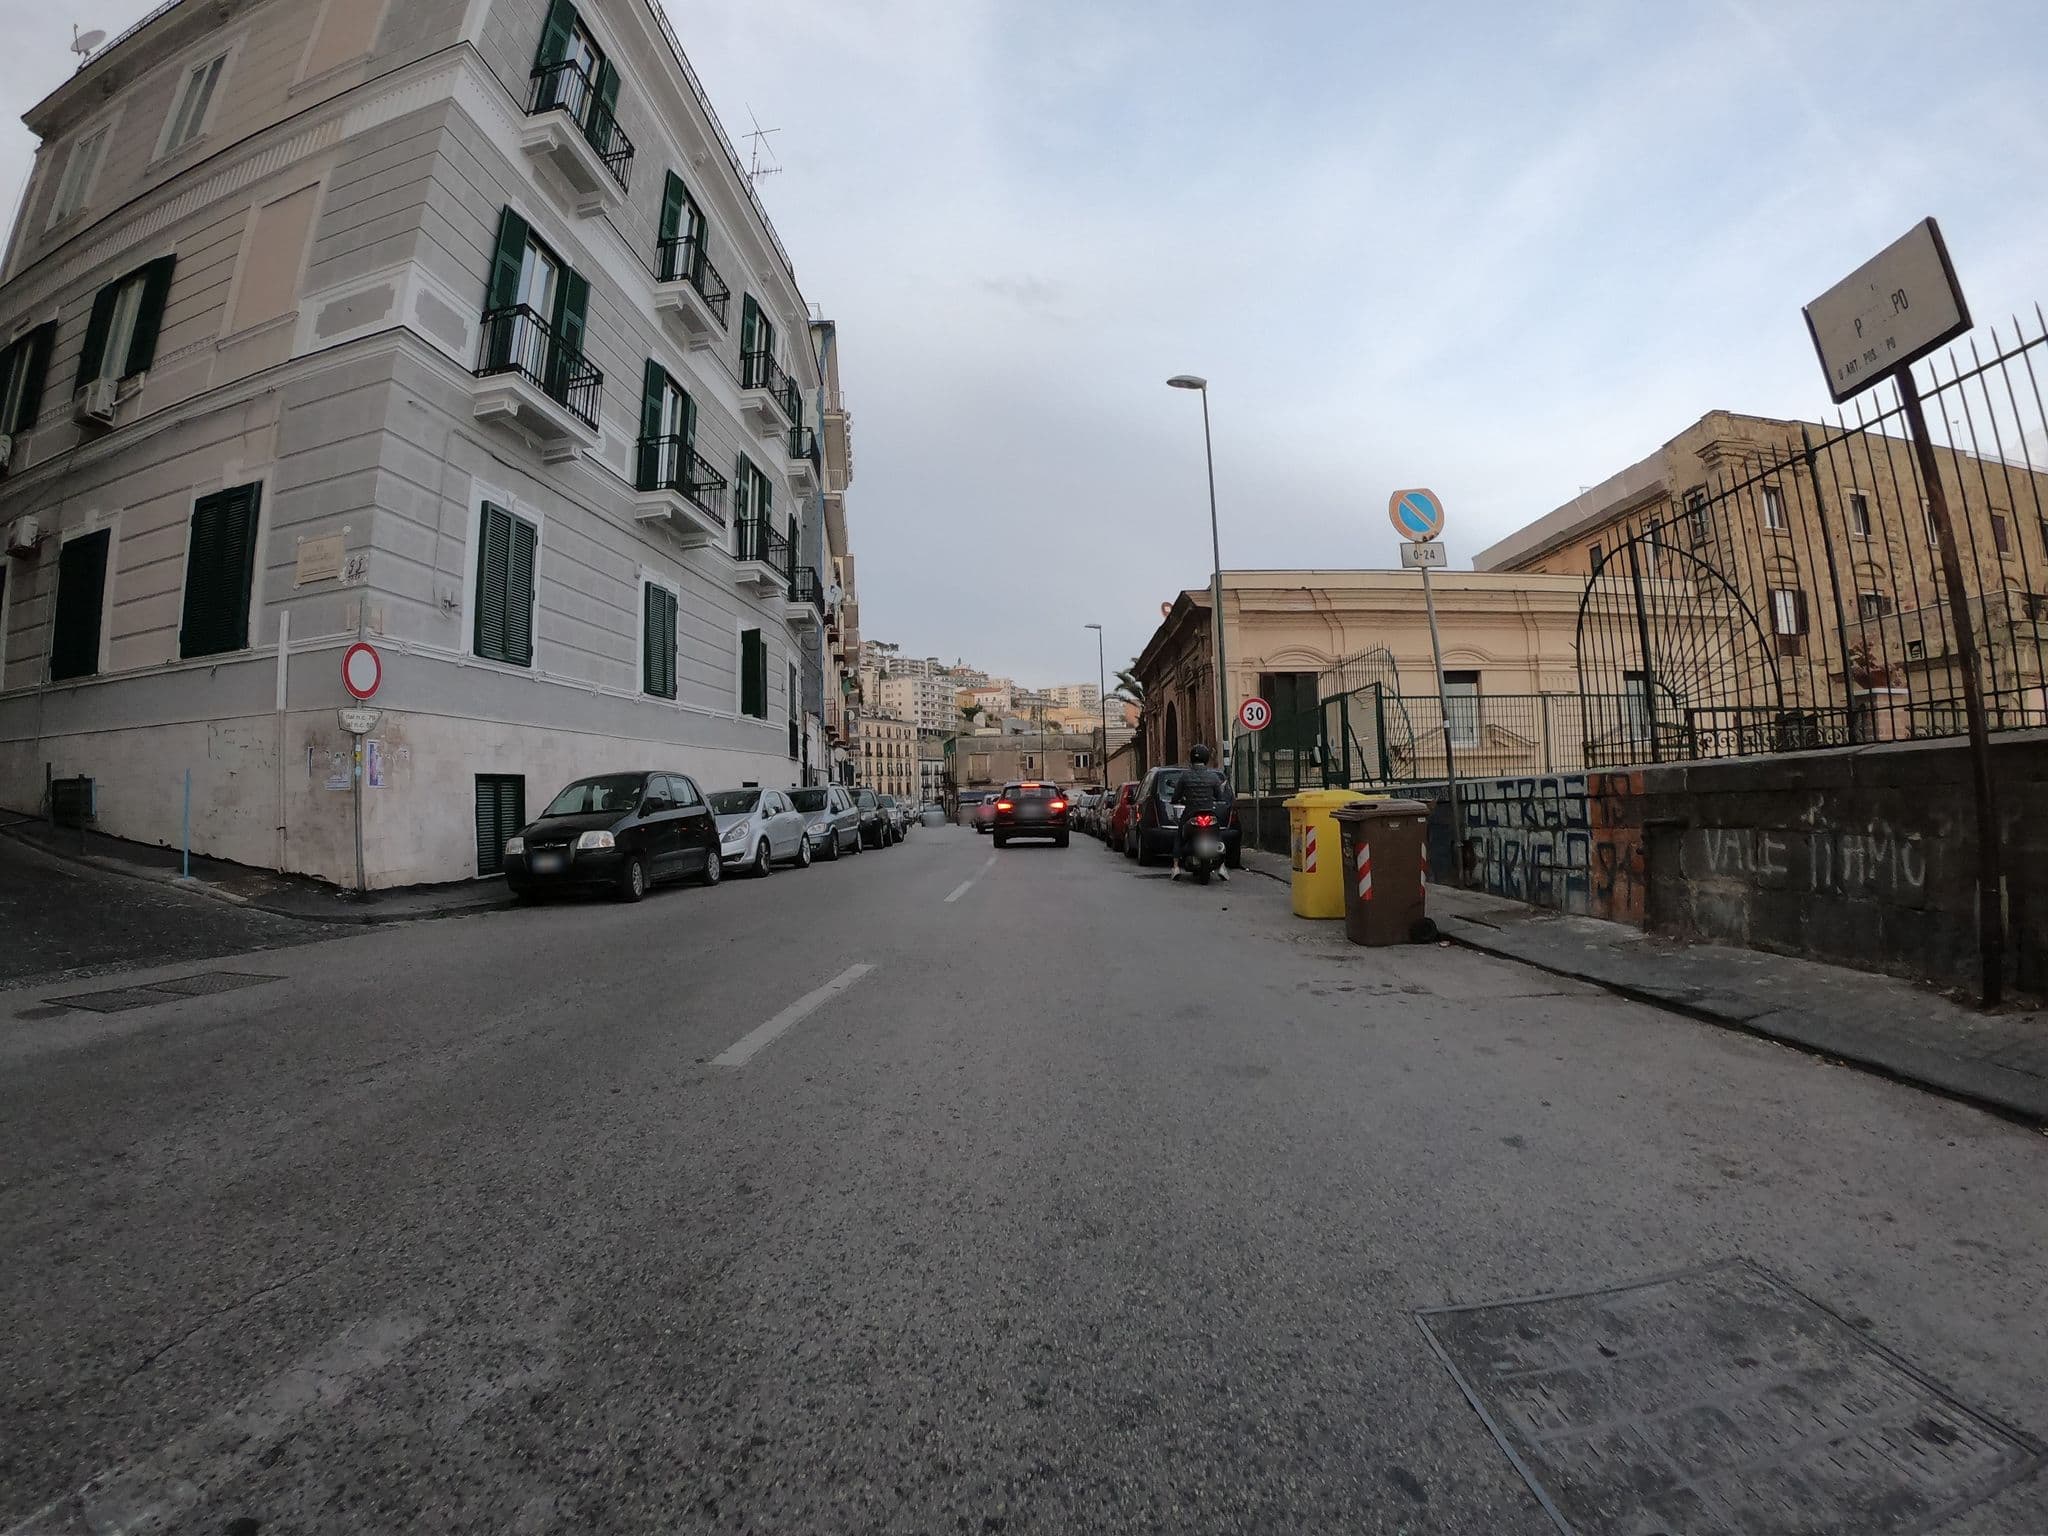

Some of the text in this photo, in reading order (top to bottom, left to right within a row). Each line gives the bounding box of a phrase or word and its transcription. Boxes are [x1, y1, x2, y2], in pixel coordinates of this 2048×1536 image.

[1413, 549, 1436, 560] 0-24
[1246, 706, 1264, 721] 30
[1463, 774, 1588, 828] ULTRAS
[1703, 829, 1788, 874] VALE
